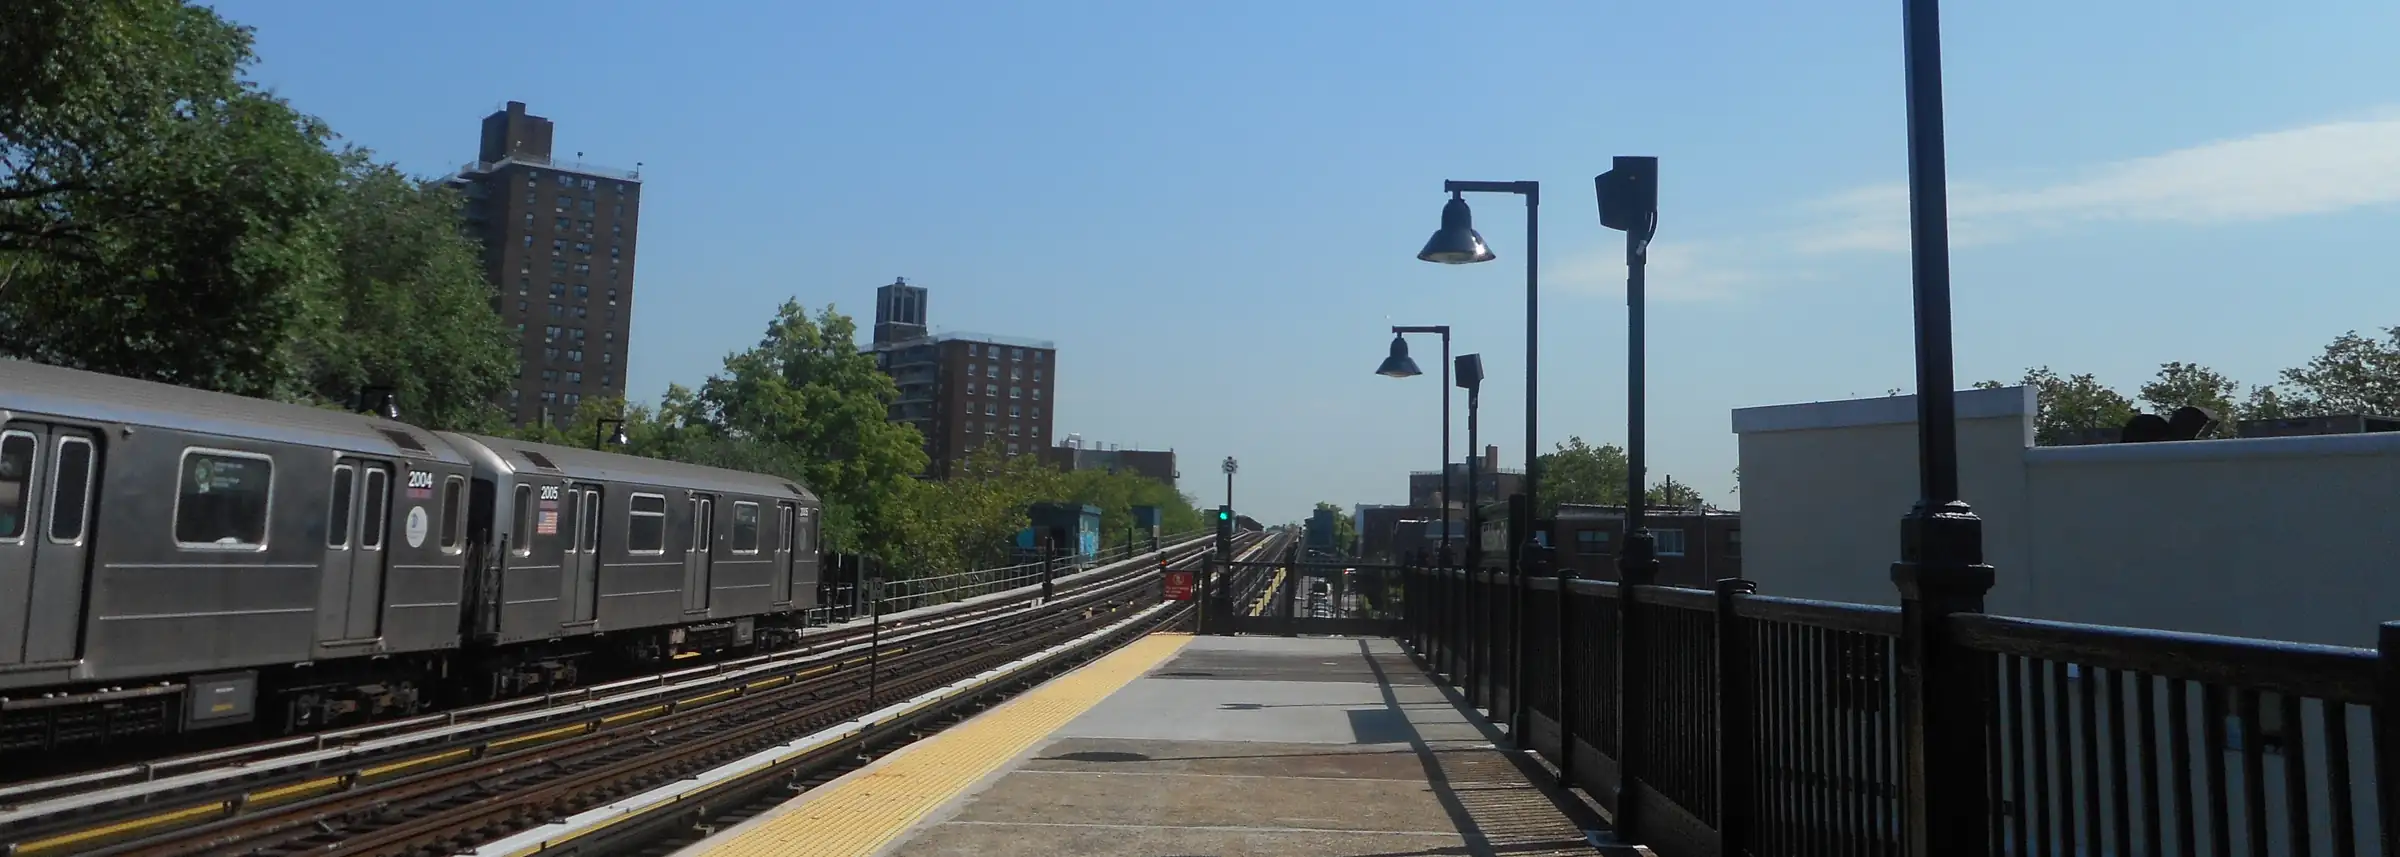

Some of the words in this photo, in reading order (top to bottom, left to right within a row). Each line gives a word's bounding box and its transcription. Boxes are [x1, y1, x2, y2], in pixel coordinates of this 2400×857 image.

[1225, 461, 1234, 472] S
[408, 471, 432, 488] 2004
[541, 486, 558, 500] 2005
